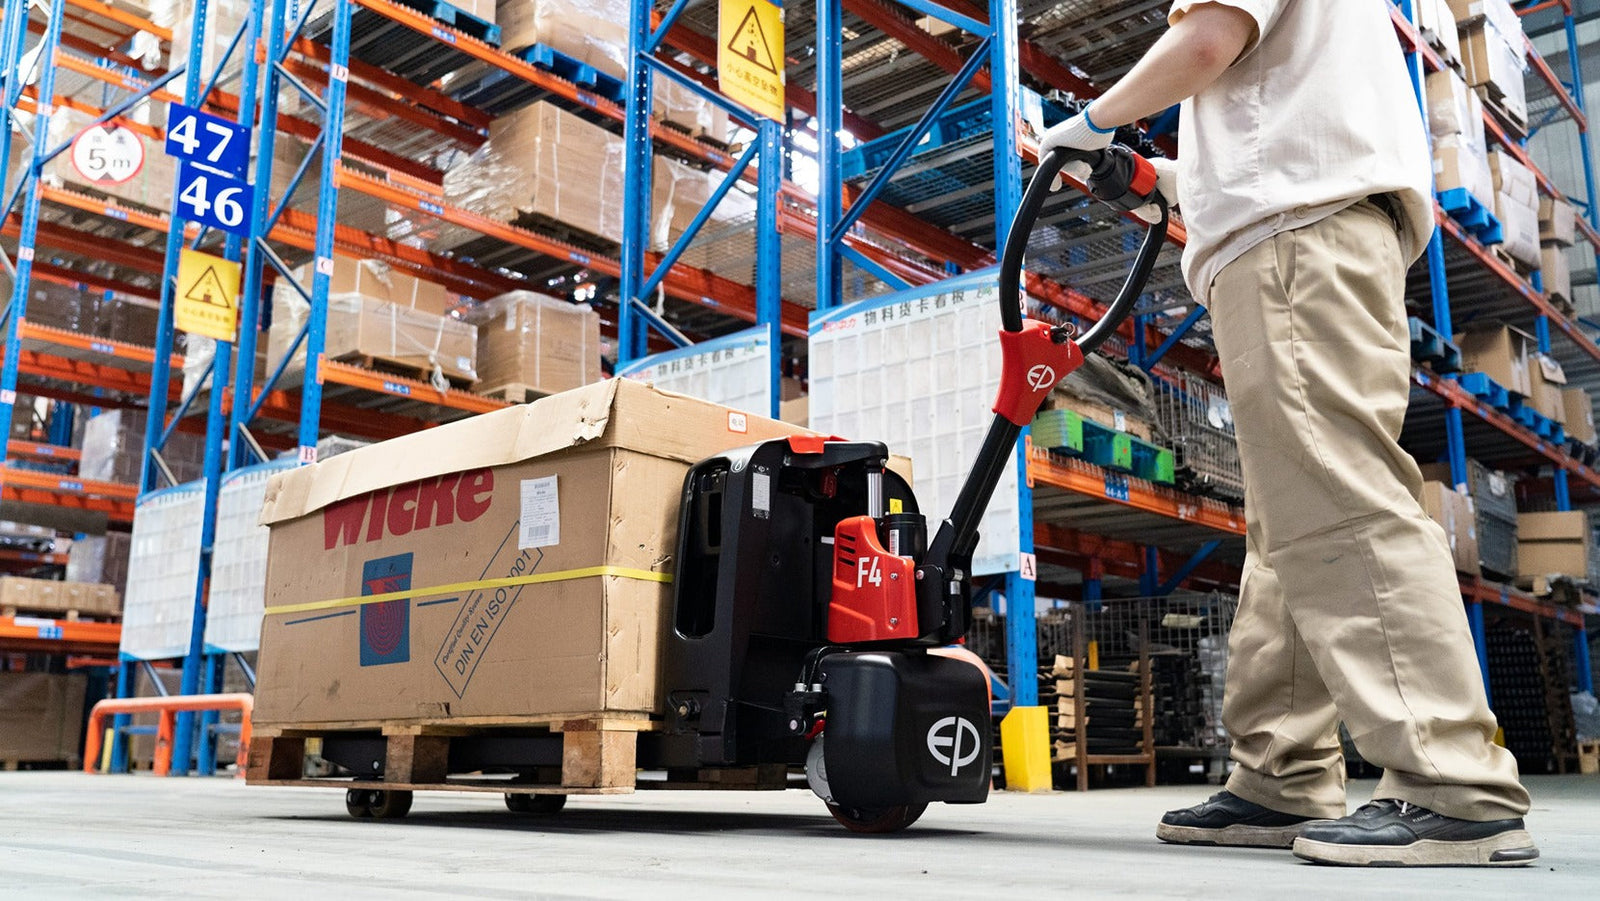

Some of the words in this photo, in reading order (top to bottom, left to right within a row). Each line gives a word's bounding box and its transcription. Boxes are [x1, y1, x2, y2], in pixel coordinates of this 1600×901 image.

[168, 115, 234, 163] 47
[179, 176, 244, 227] 46
[857, 556, 882, 588] F4
[1023, 558, 1034, 576] A
[455, 642, 475, 676] DIN
[470, 617, 490, 646] EN
[485, 588, 507, 620] ISO
